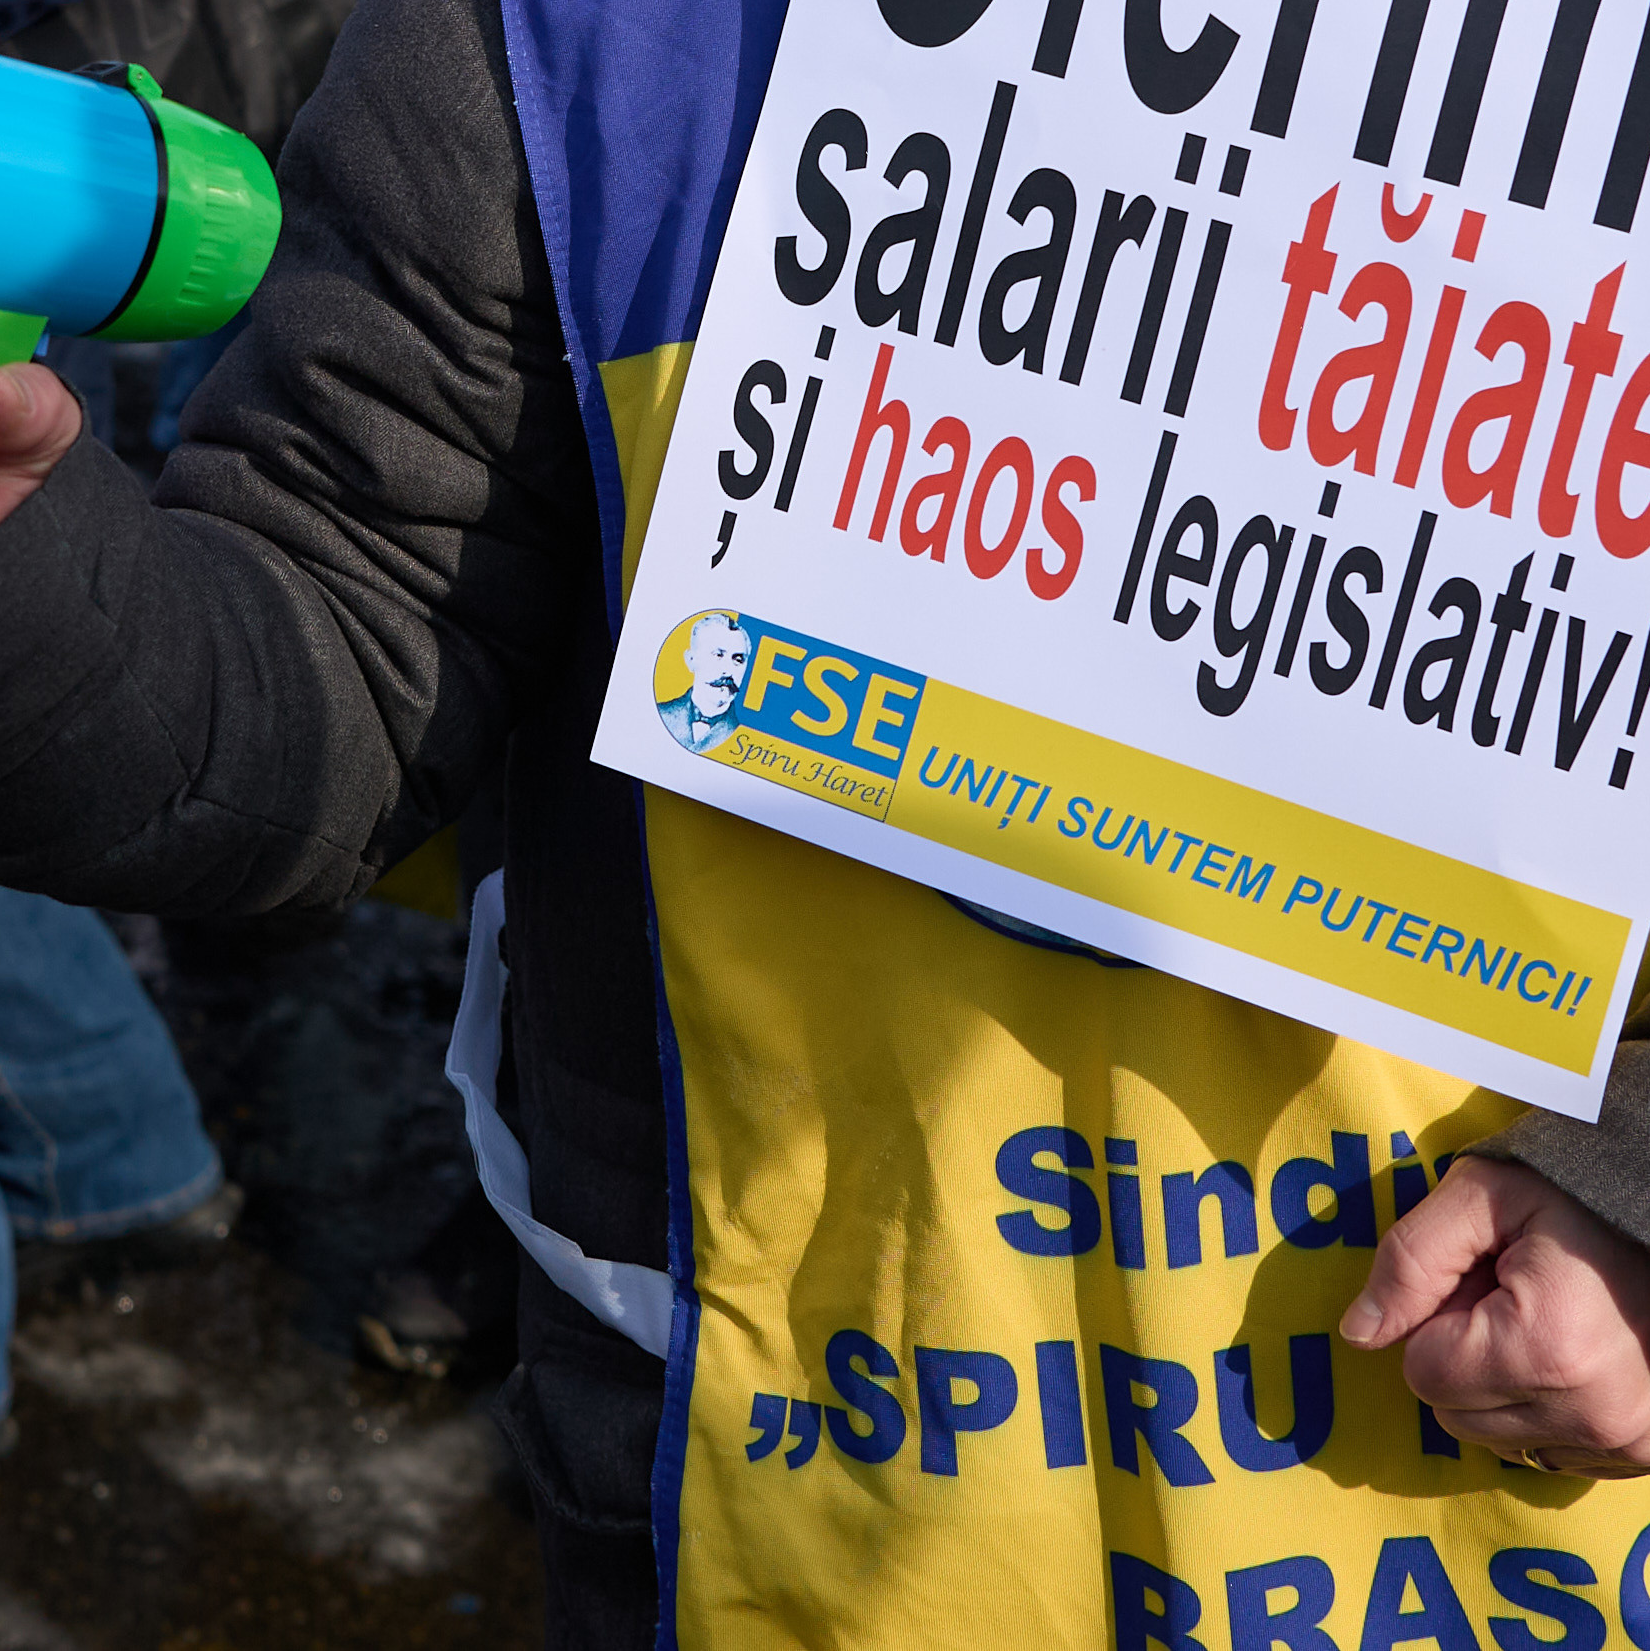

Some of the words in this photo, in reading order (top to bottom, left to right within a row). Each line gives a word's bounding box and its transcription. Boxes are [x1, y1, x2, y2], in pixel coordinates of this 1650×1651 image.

[774, 80, 1252, 419] salarii
[710, 324, 837, 569] și
[832, 343, 1097, 601] haos
[728, 733, 800, 778] Spiru
[802, 761, 890, 808] Haret
[742, 634, 919, 762] FSE
[917, 745, 1052, 831] UNIȚI
[1056, 796, 1276, 904] SUNTEM
[1281, 875, 1593, 1017] PUTERNICI!
[995, 1126, 1456, 1271] Sindi
